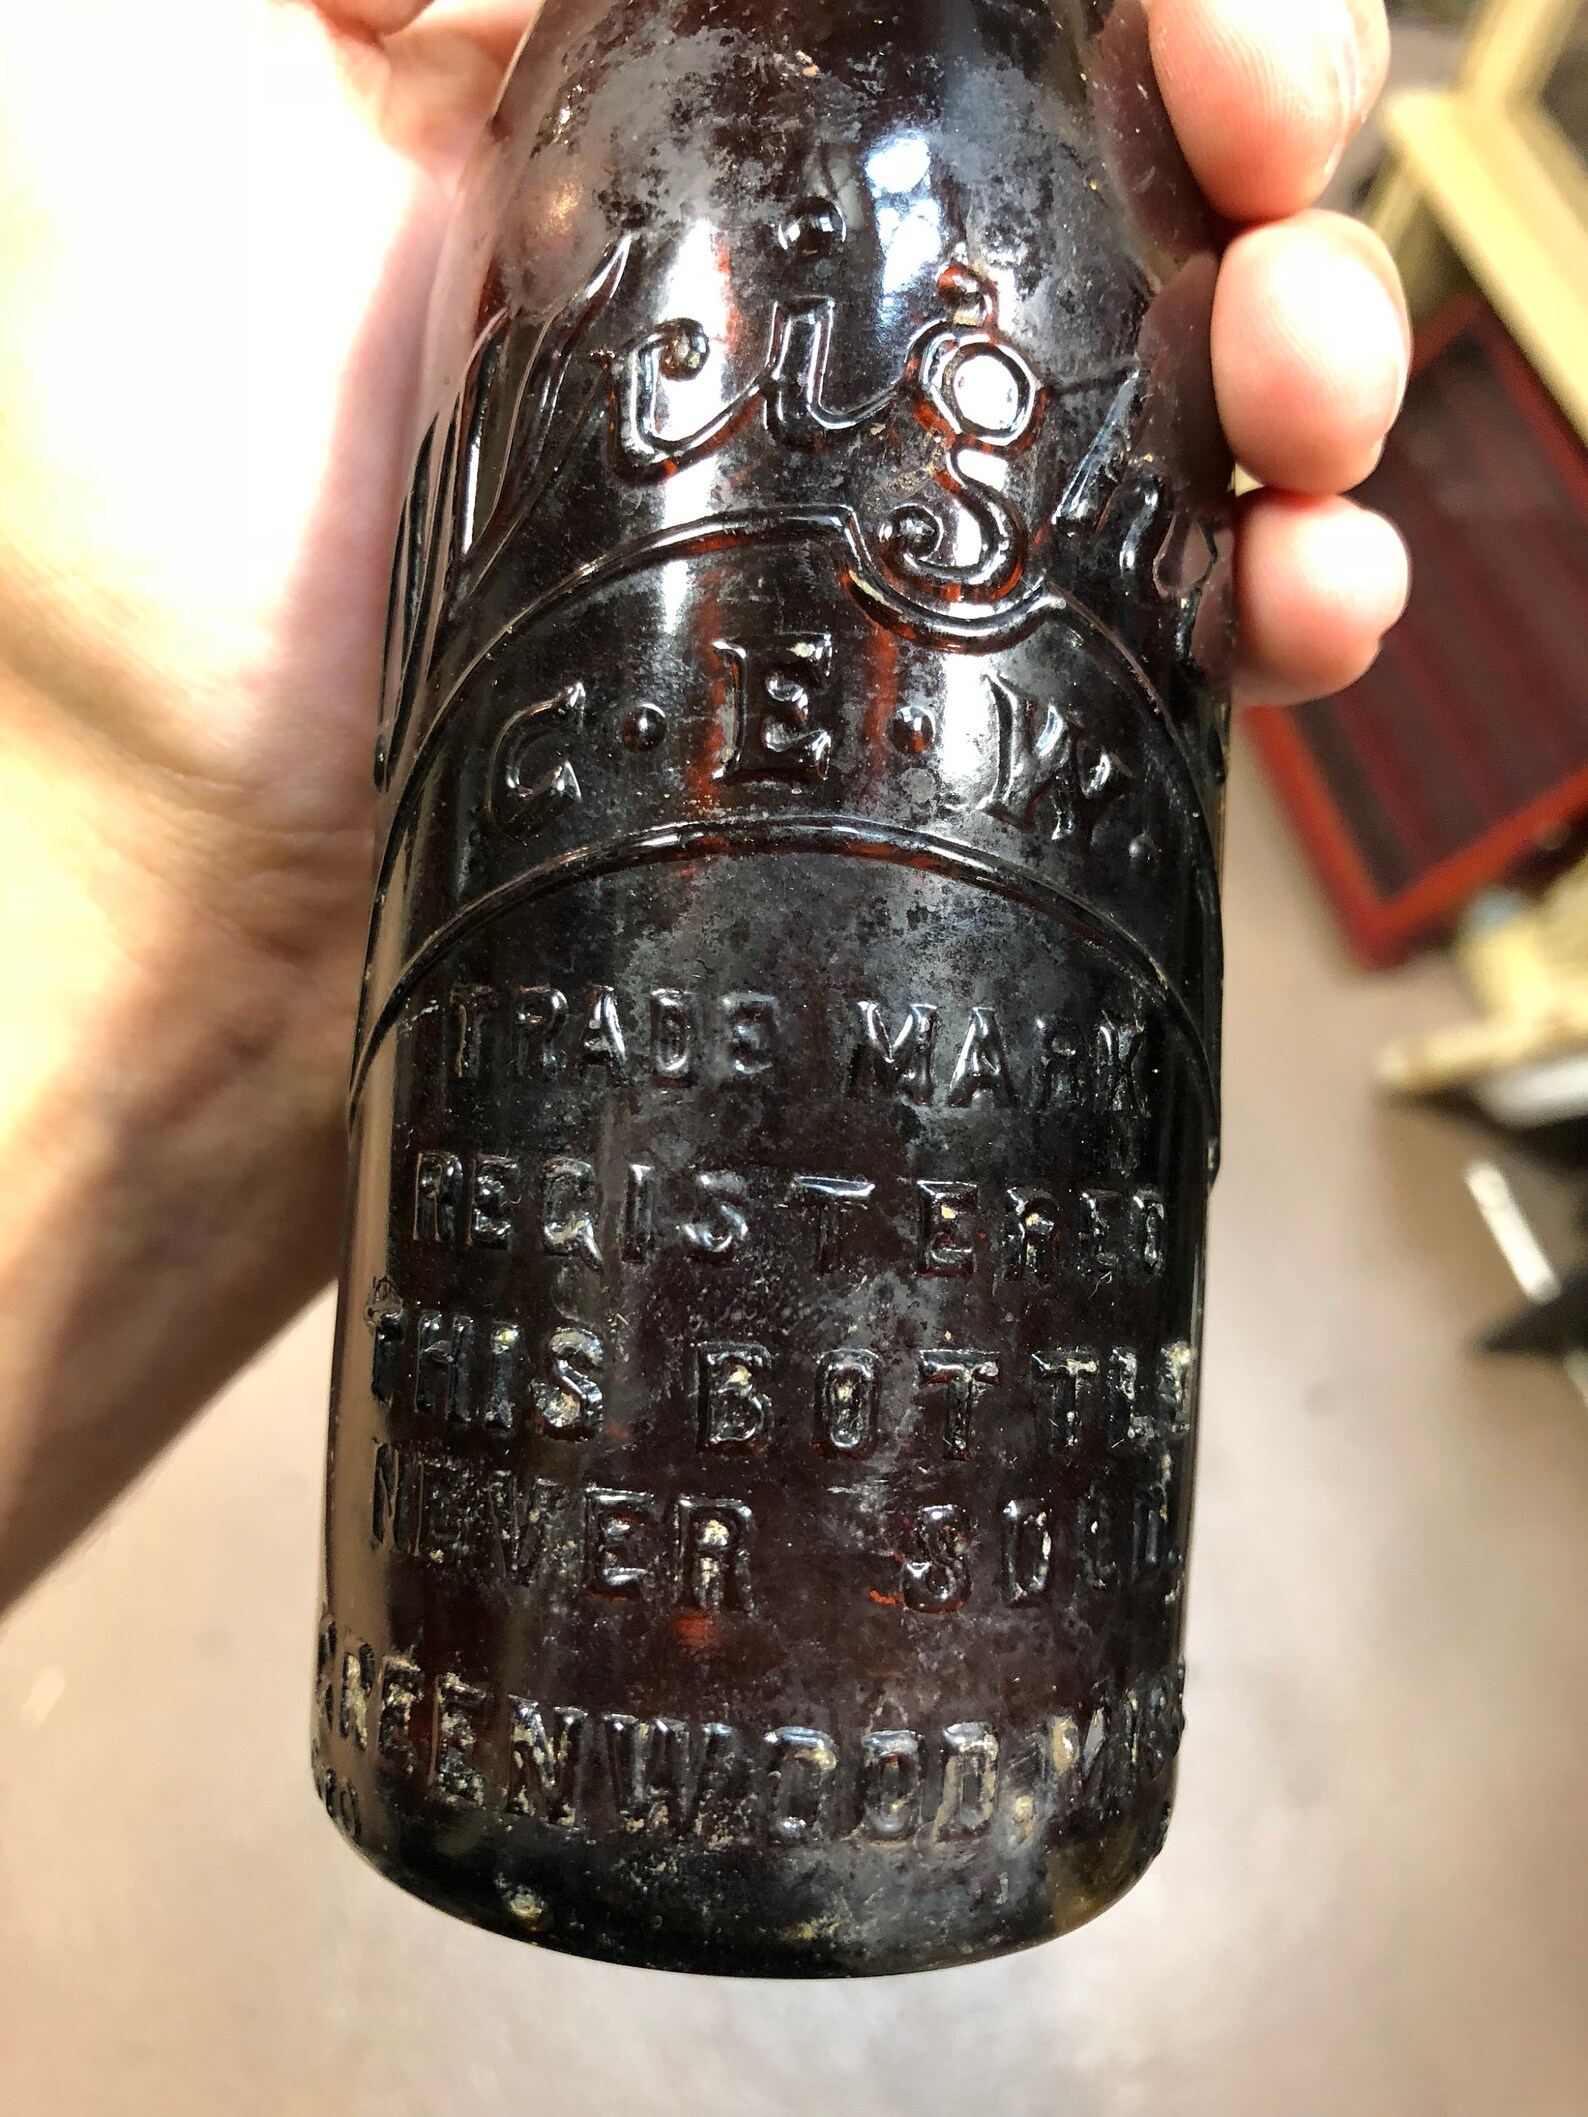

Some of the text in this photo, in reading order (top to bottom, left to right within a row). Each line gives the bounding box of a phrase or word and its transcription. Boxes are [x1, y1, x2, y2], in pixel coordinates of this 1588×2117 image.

[448, 983, 778, 1096] TRADE
[412, 1150, 1166, 1276] REGISTERED
[372, 1443, 754, 1612] NEVER
